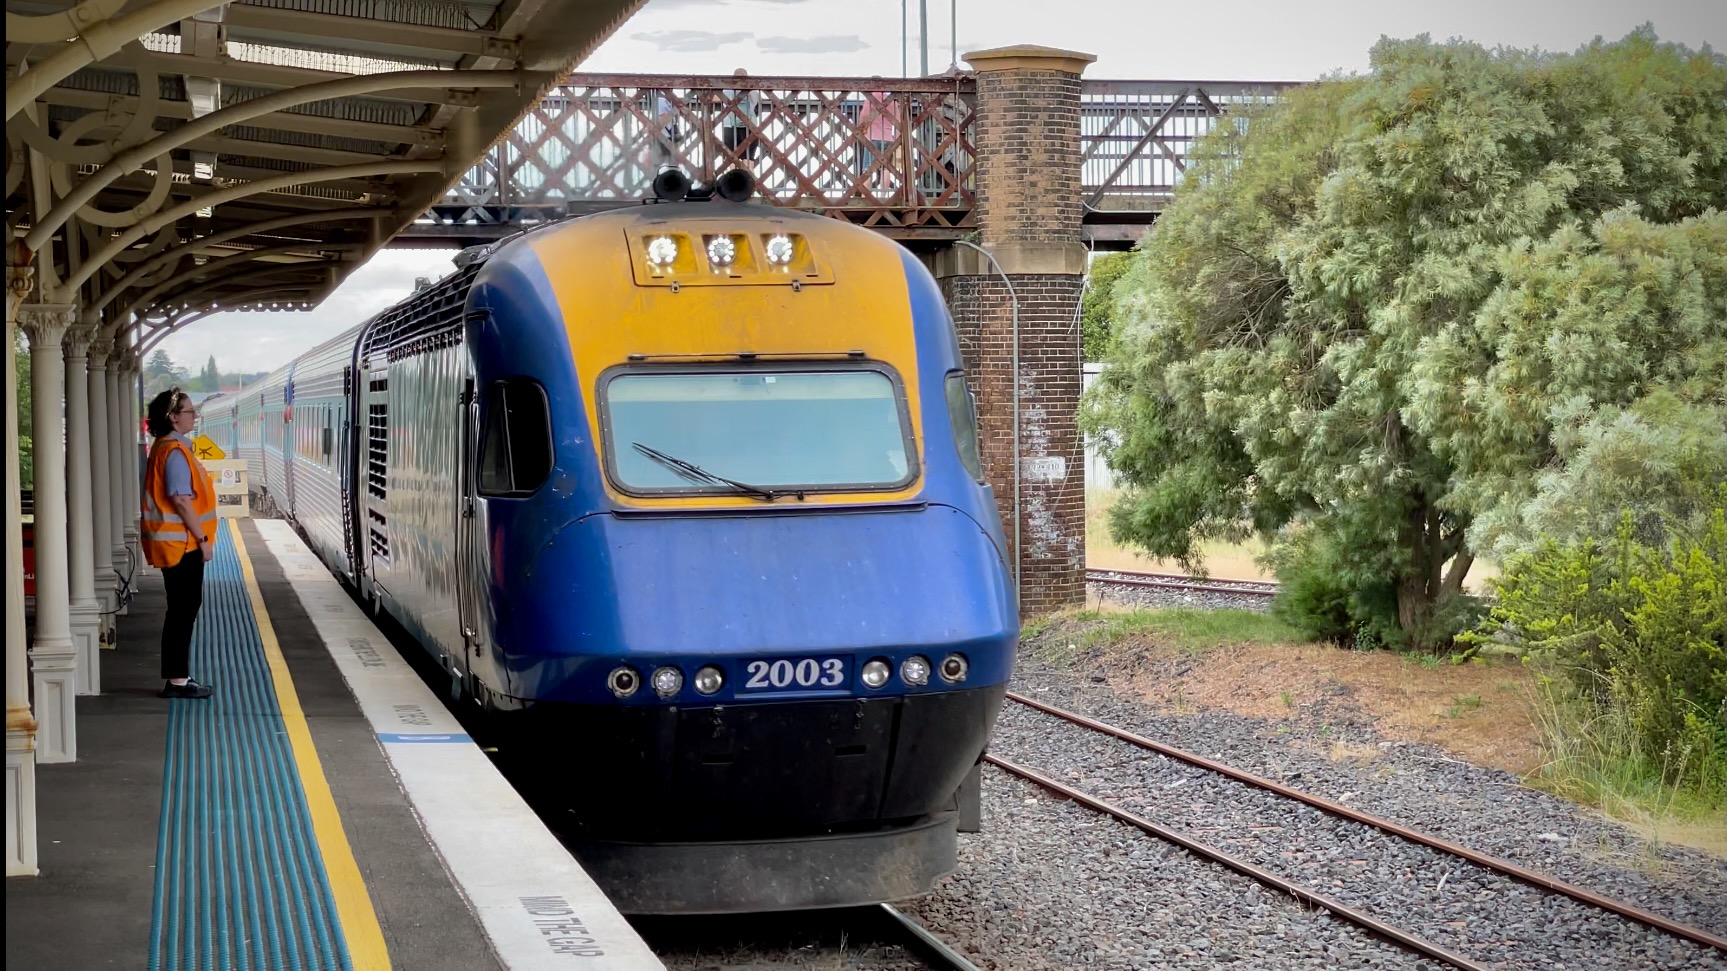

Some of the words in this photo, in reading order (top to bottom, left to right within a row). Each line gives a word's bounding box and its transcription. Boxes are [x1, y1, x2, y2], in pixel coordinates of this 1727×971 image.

[745, 658, 845, 688] 2003
[517, 895, 575, 916] MIND
[532, 917, 590, 936] THE
[546, 937, 605, 957] GAP
